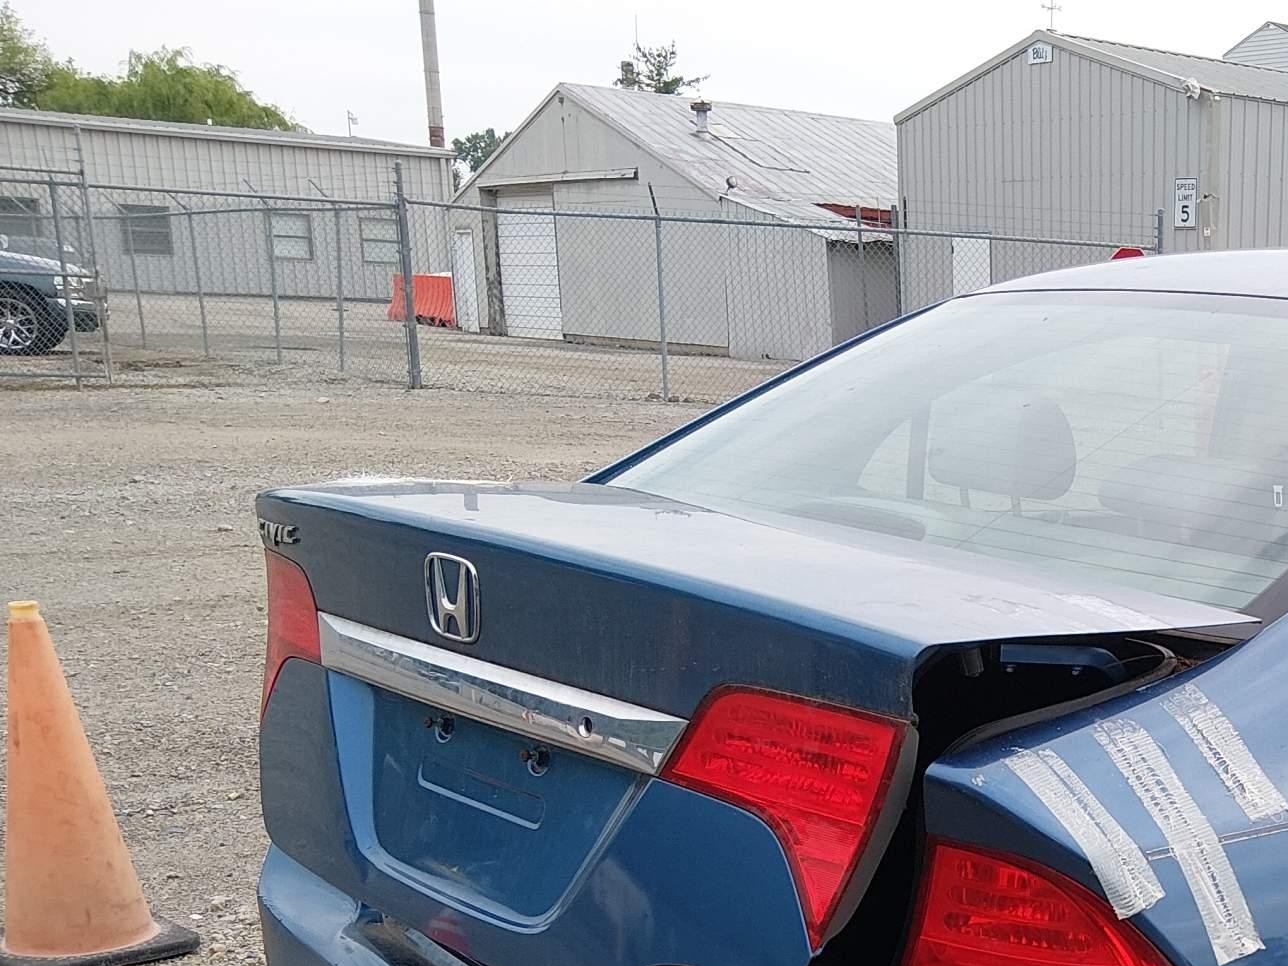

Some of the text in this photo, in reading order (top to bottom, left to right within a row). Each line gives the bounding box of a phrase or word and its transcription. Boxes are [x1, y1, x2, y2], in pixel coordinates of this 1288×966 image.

[1176, 183, 1195, 191] SPEED
[1177, 193, 1193, 201] LIMIT
[1180, 204, 1190, 223] 5
